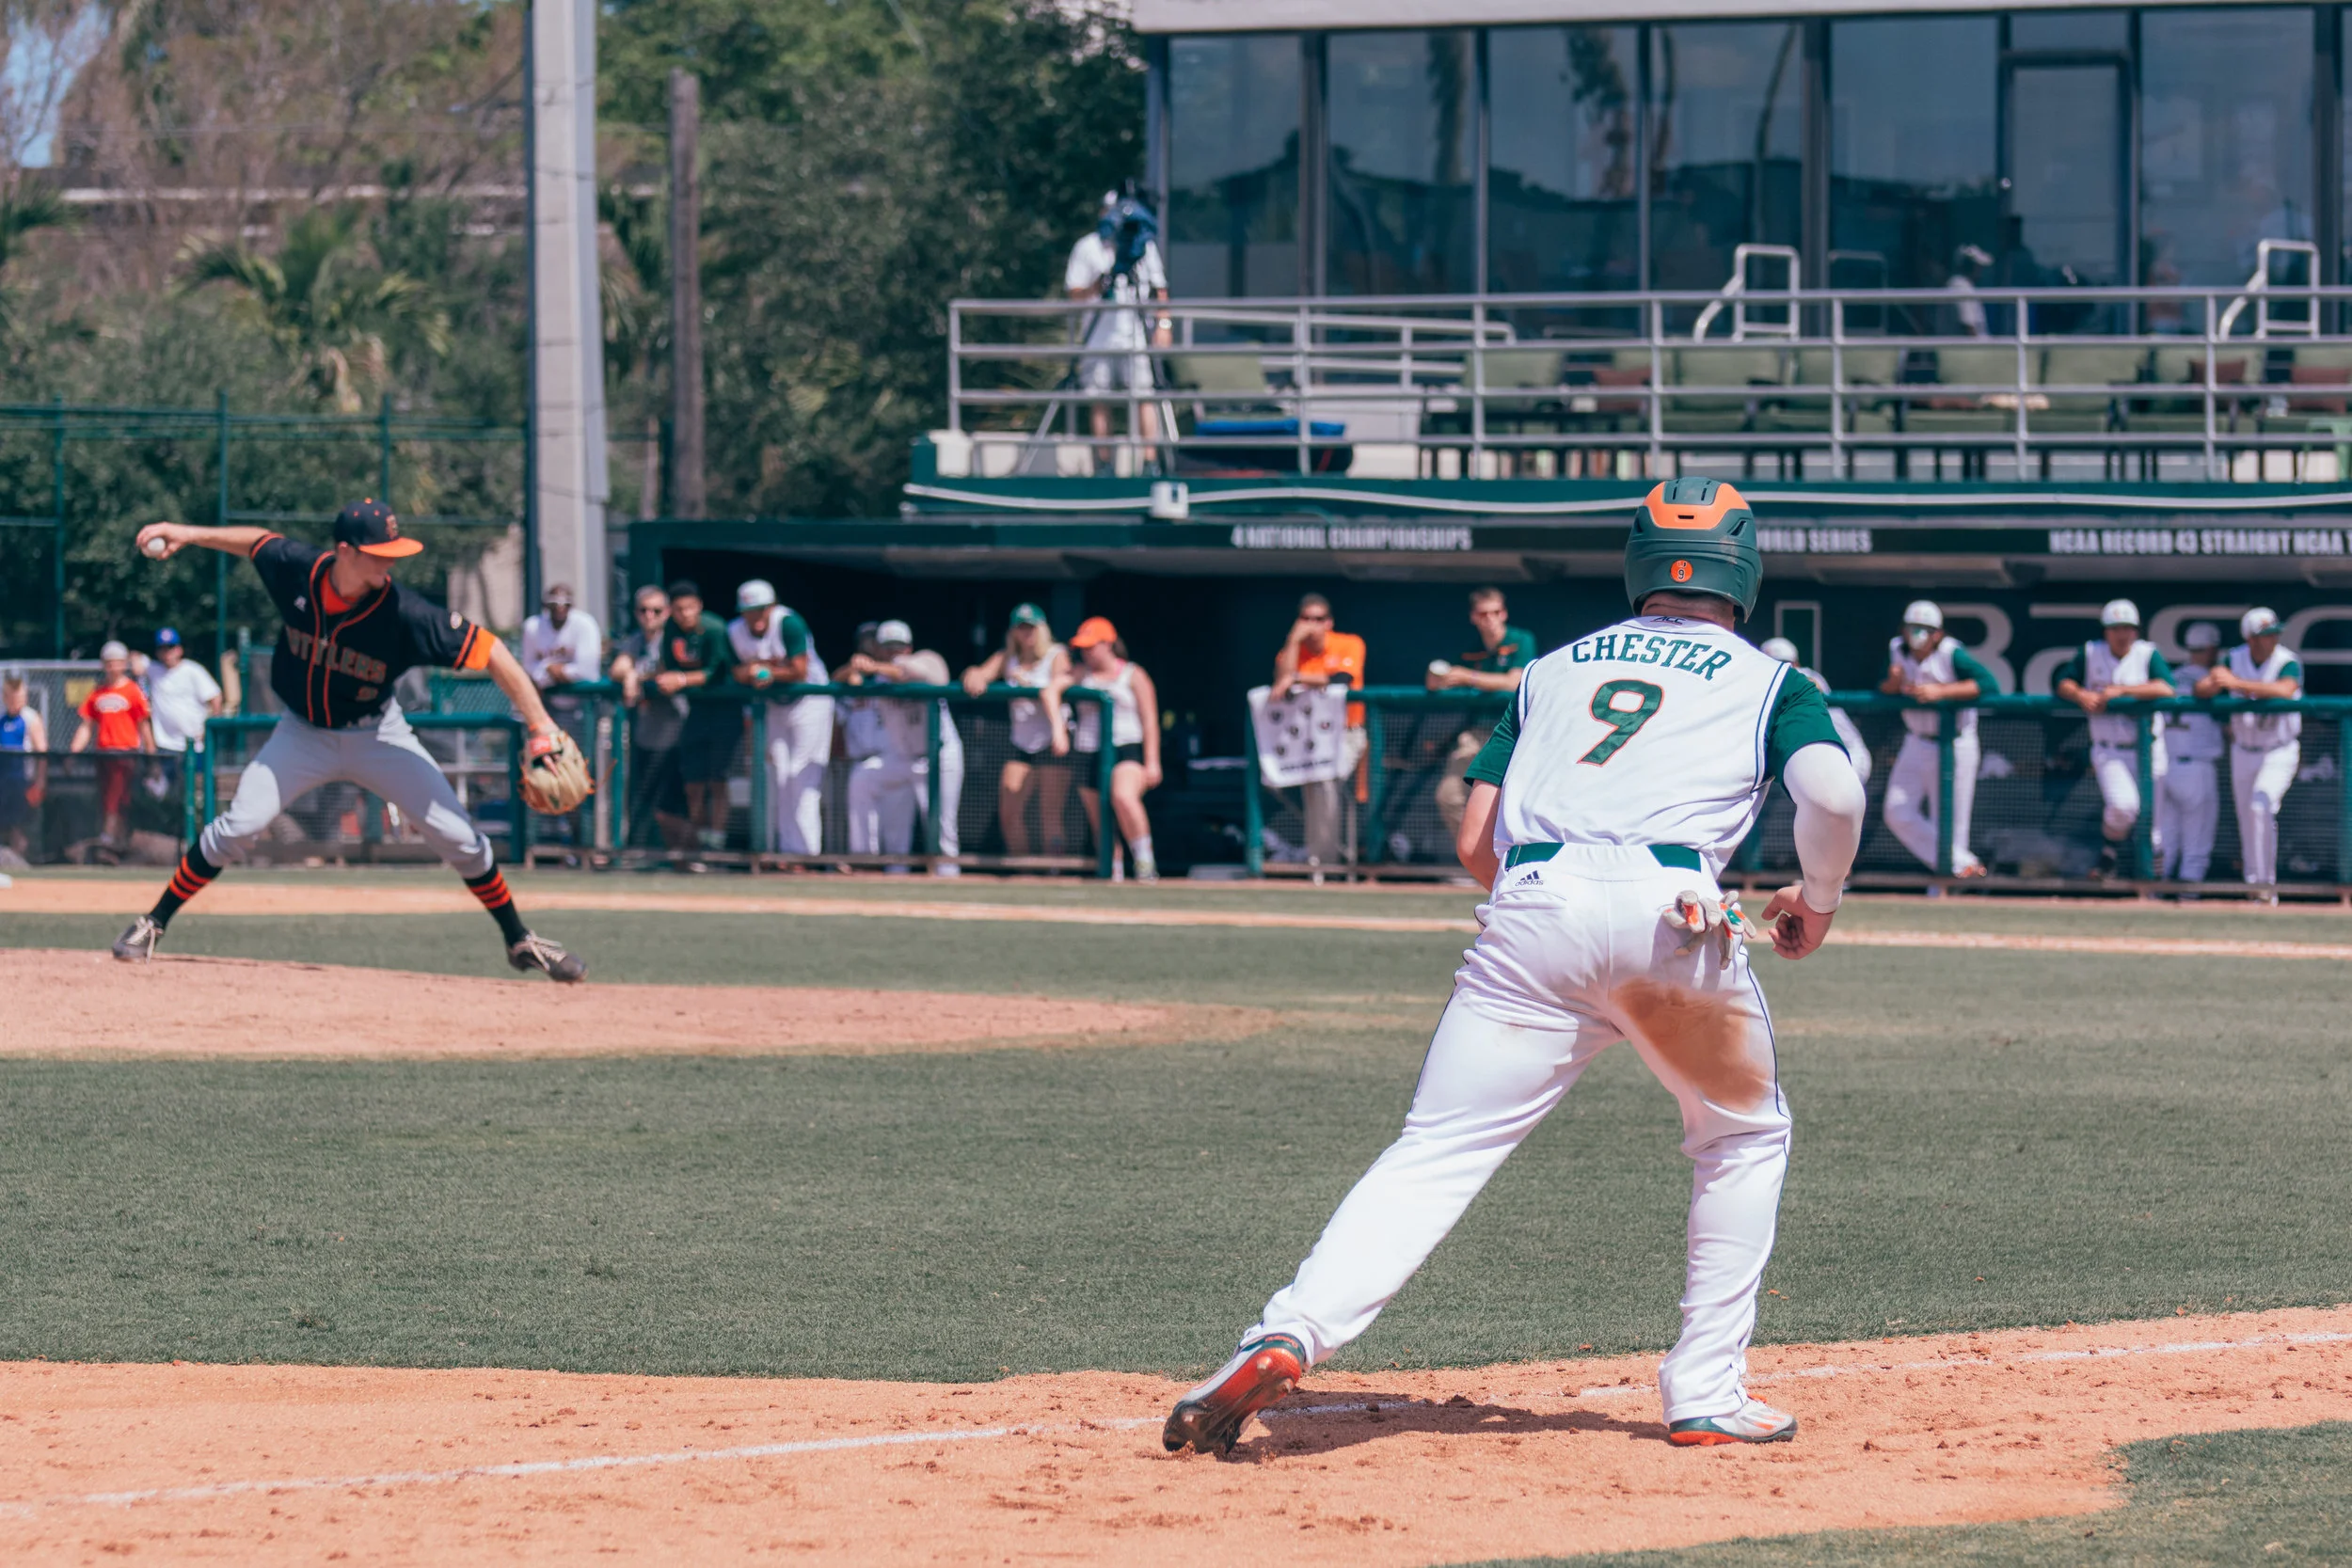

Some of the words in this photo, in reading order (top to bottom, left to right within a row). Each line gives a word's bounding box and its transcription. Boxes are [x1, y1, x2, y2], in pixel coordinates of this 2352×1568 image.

[1247, 526, 1327, 548] NATIONAL
[1328, 526, 1472, 549] CHAMPIONSHIPS
[1756, 528, 1806, 551] ORLD
[1808, 528, 1871, 552] SERIES
[2049, 530, 2099, 553] NCAA
[2102, 530, 2173, 553] RECORD
[2200, 530, 2291, 554] STRAIGHT
[2294, 530, 2344, 554] NCAA
[1677, 568, 1686, 579] 9
[1572, 633, 1732, 681] CHESTER
[1576, 678, 1665, 768] 9
